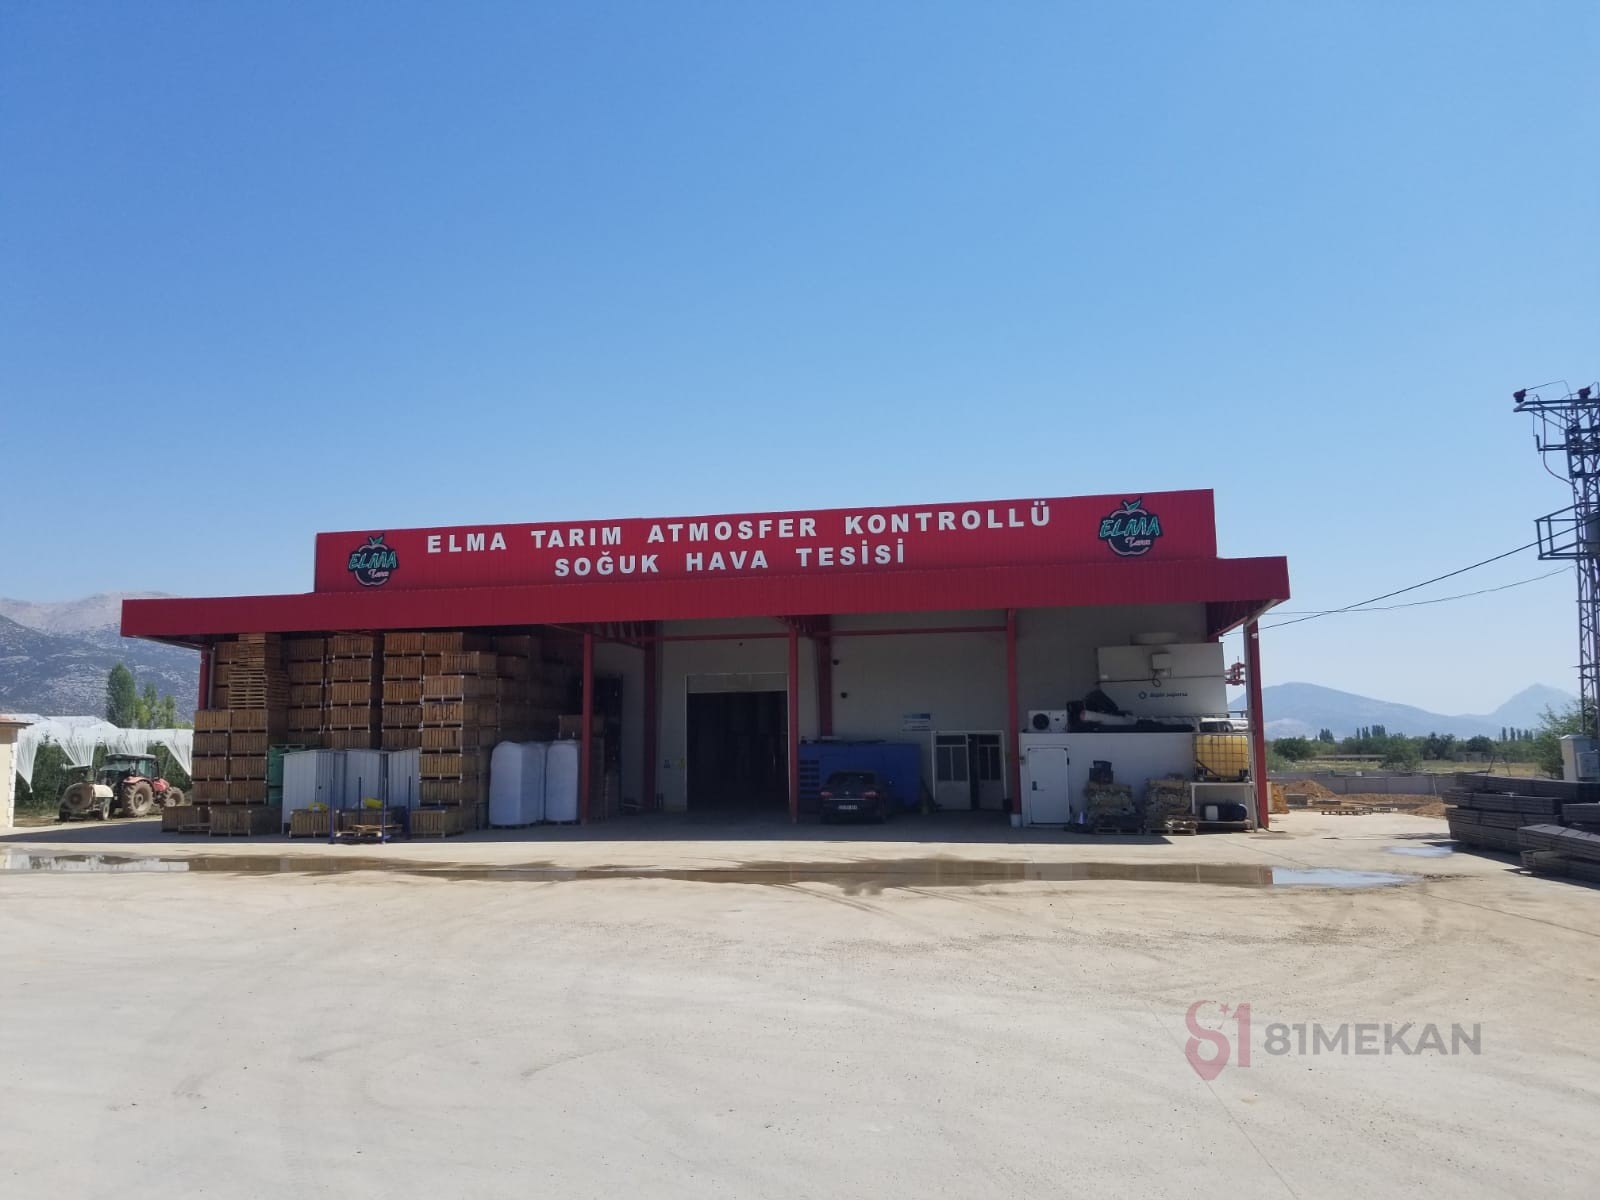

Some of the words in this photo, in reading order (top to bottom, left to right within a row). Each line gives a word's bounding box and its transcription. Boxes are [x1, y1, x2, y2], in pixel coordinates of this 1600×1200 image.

[427, 532, 507, 553] ELMA
[530, 526, 622, 549] TARIM
[647, 517, 817, 543] ATMOSFER
[844, 499, 1050, 535] KONTROLLÜ
[1100, 516, 1160, 538] ELMA
[348, 551, 397, 570] ELMA
[555, 551, 660, 577] SOĞUK
[686, 550, 768, 571] HAVA
[795, 538, 905, 567] TESİSİ
